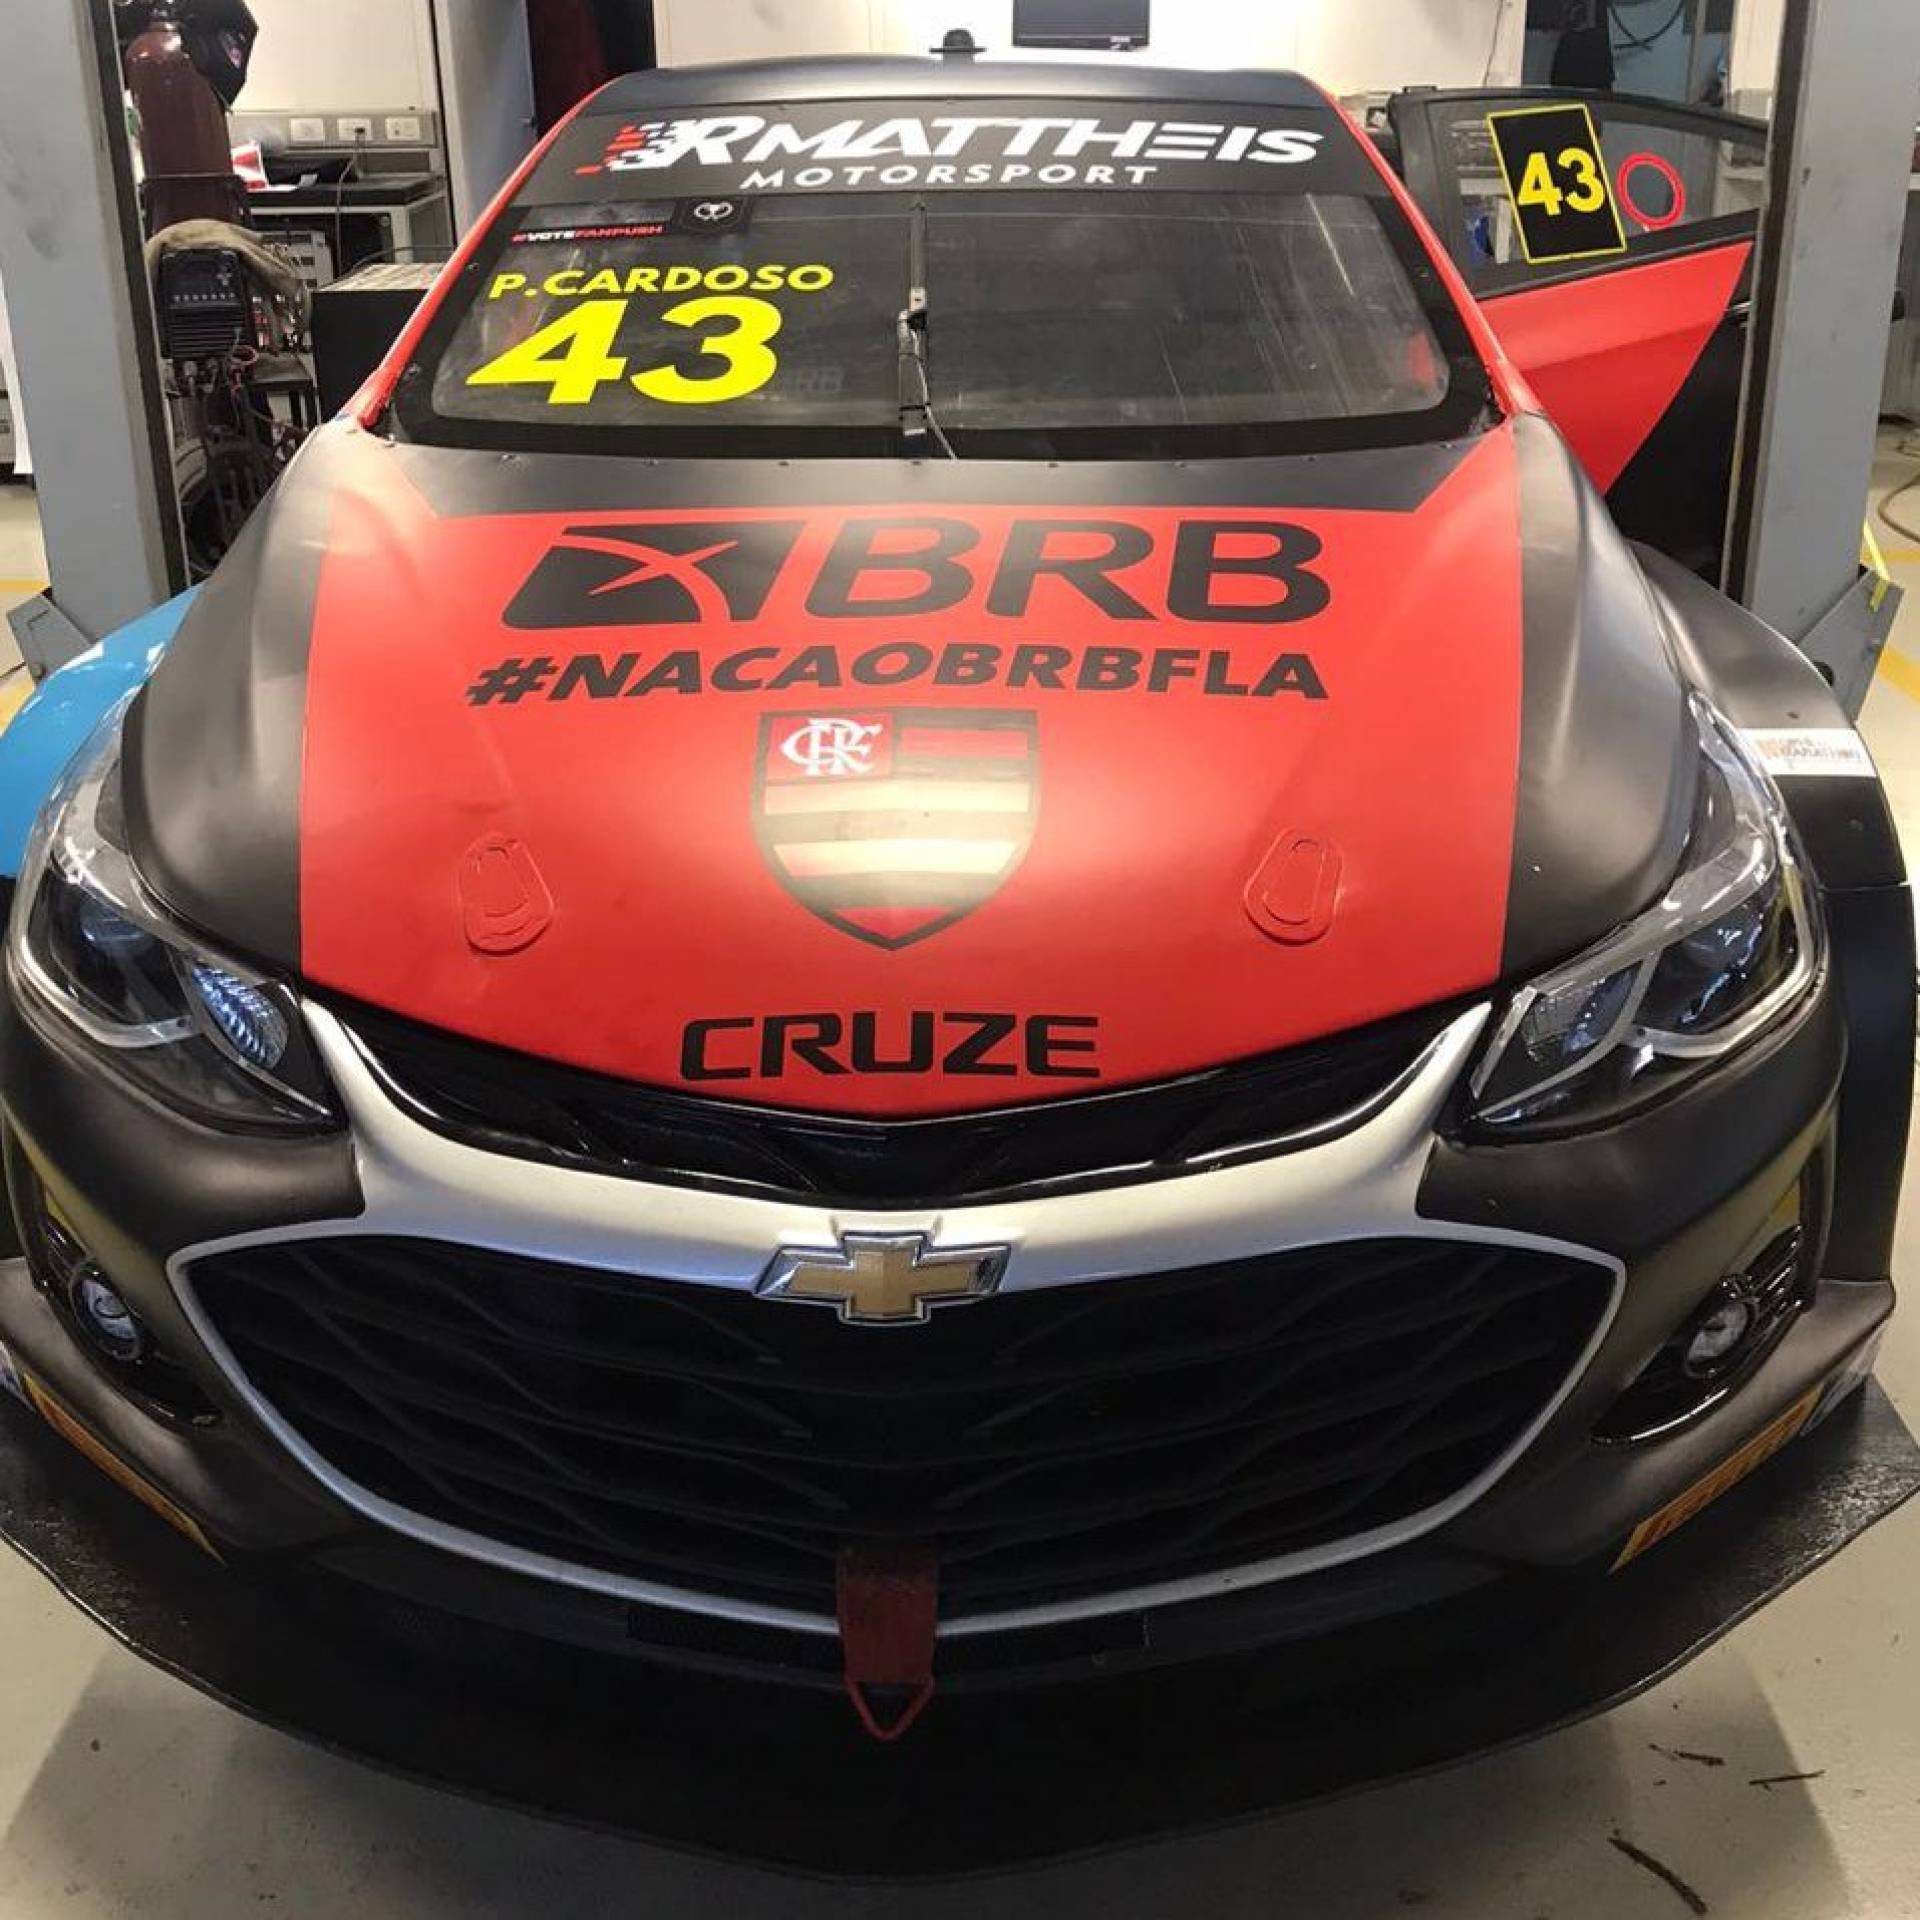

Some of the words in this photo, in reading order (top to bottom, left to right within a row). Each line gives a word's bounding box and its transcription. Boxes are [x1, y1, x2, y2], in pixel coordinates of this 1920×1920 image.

[739, 164, 1158, 190] MOTORSPORT
[1517, 147, 1606, 216] 43
[489, 264, 834, 299] P.CARDOSO
[464, 295, 783, 404] 43
[804, 517, 1331, 624] BRB
[465, 641, 1329, 706] #NACAOBRBFLA
[680, 1010, 1101, 1081] CRUZE
